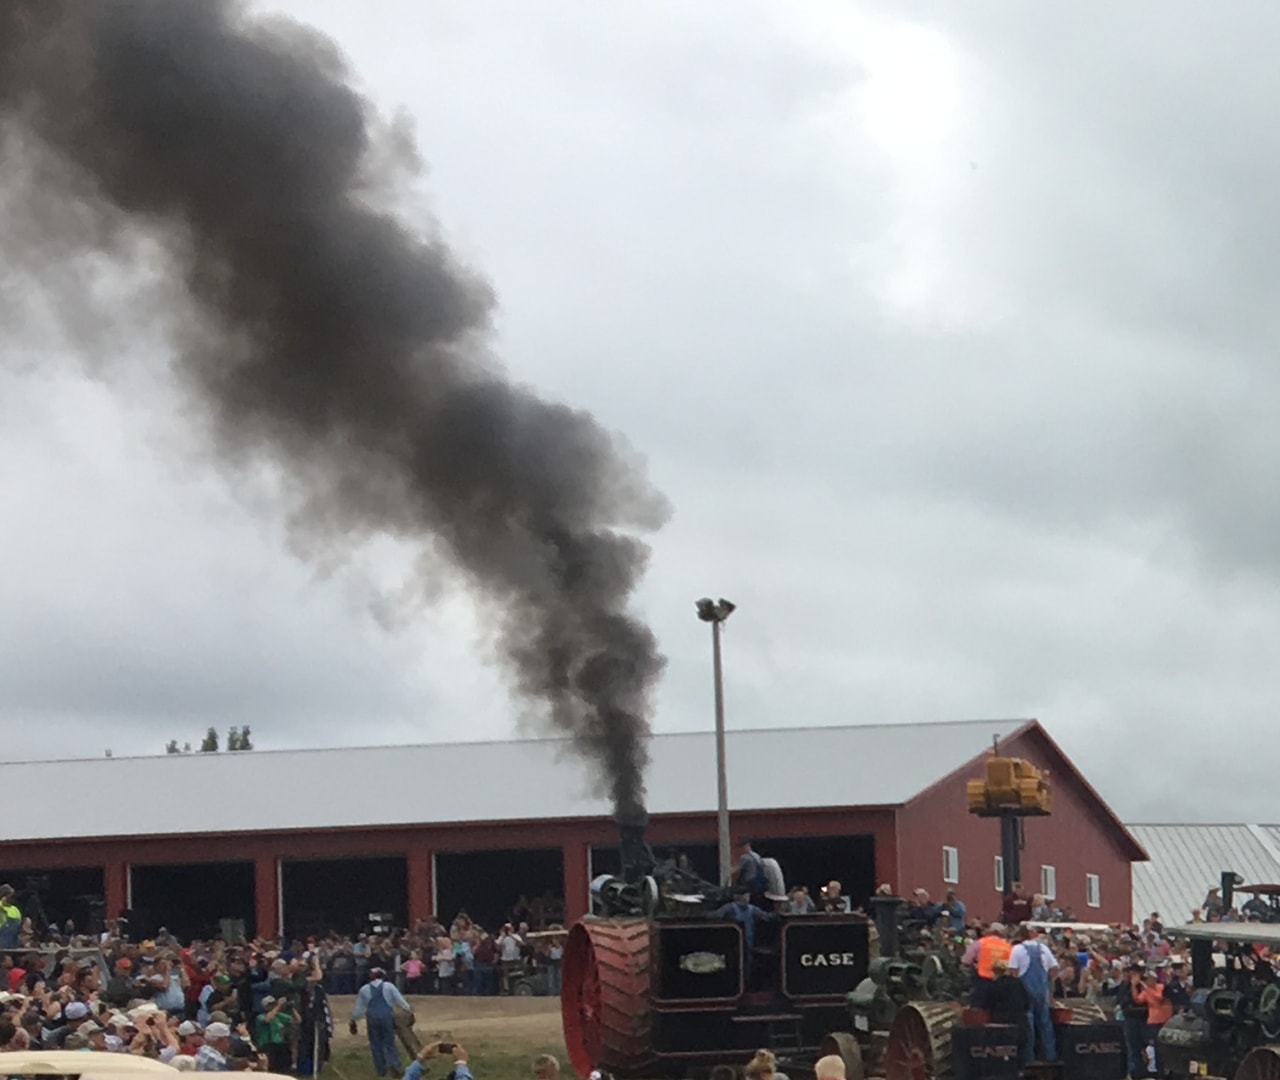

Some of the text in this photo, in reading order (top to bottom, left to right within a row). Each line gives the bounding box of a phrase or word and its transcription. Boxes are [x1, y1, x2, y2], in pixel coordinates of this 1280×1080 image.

[800, 953, 855, 967] CASE
[970, 1045, 1018, 1058] CASE
[1075, 1042, 1121, 1054] CASE
